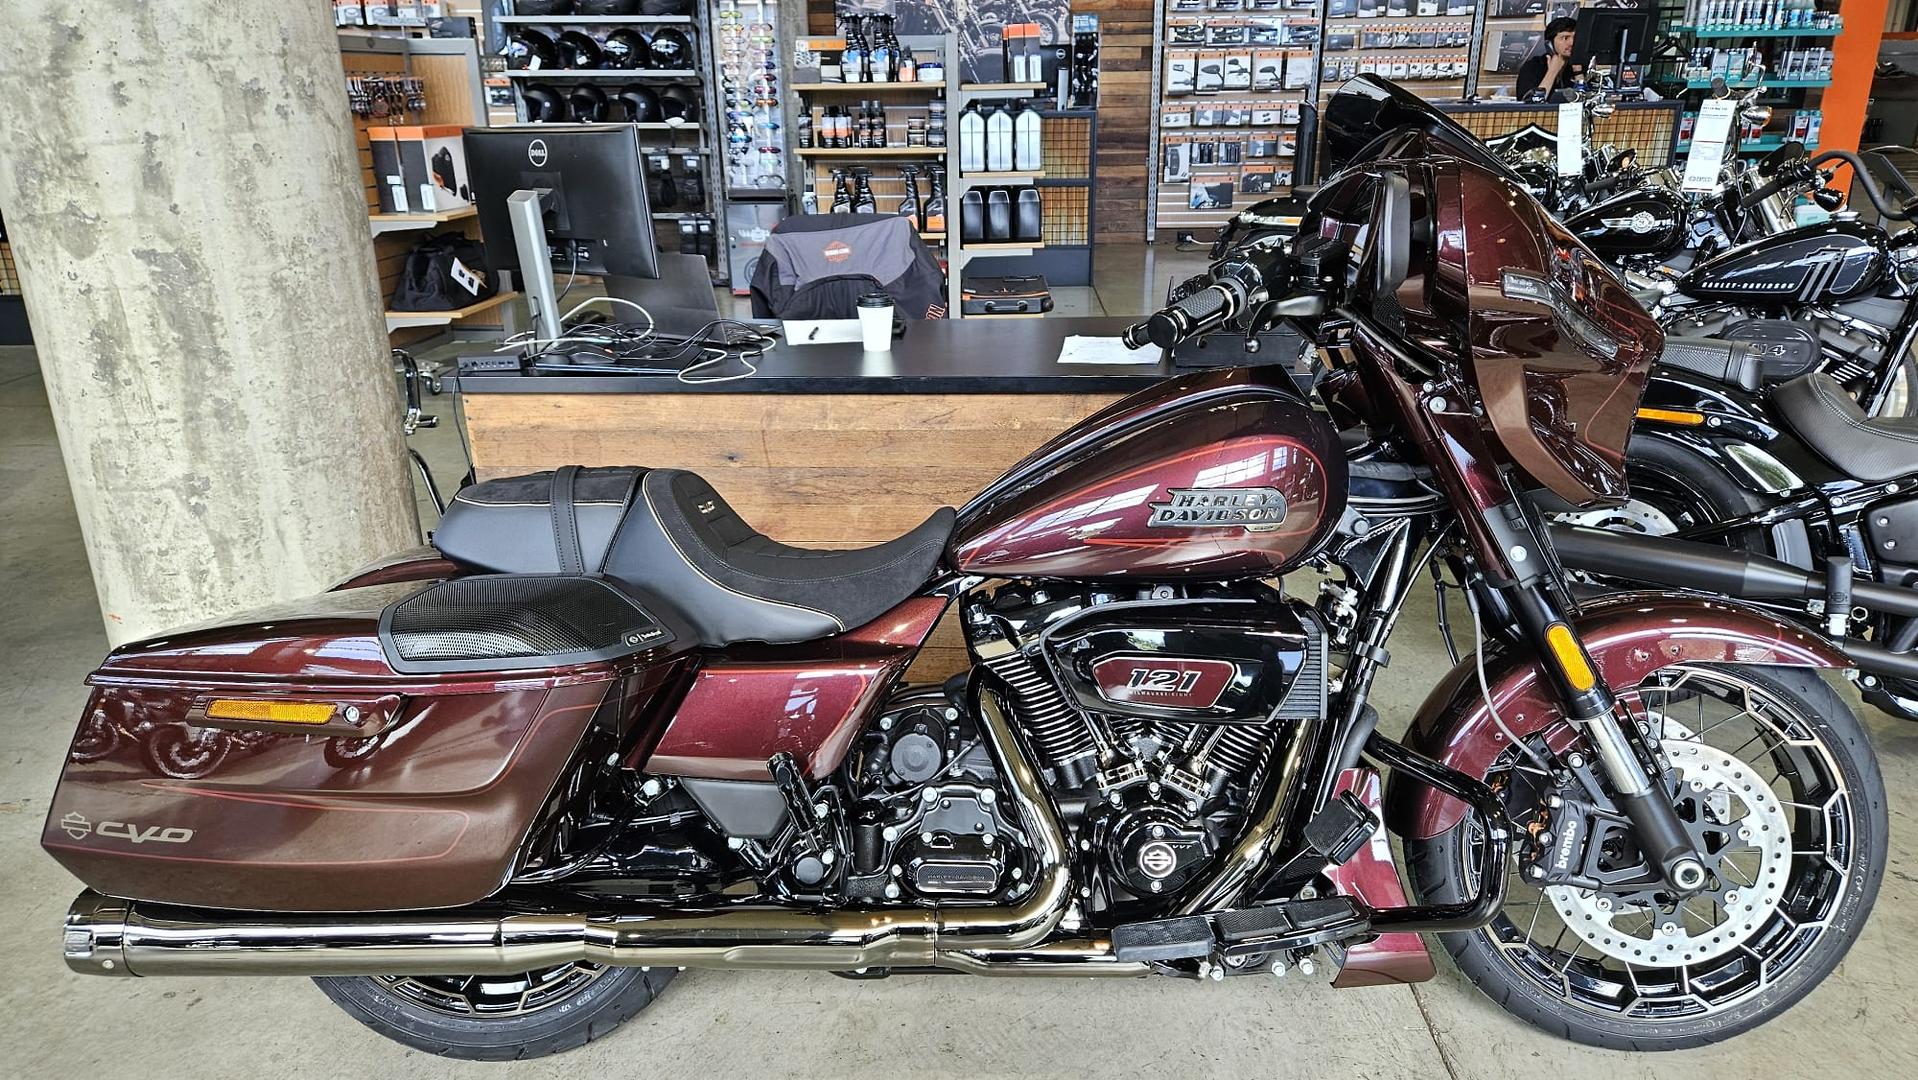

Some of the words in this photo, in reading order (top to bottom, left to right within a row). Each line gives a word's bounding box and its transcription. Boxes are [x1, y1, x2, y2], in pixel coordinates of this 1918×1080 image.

[1178, 493, 1272, 507] HARLEY
[1159, 507, 1279, 522] DAVIDSON
[1127, 668, 1202, 692] 121
[96, 822, 193, 843] CVO
[1555, 820, 1577, 869] brembo
